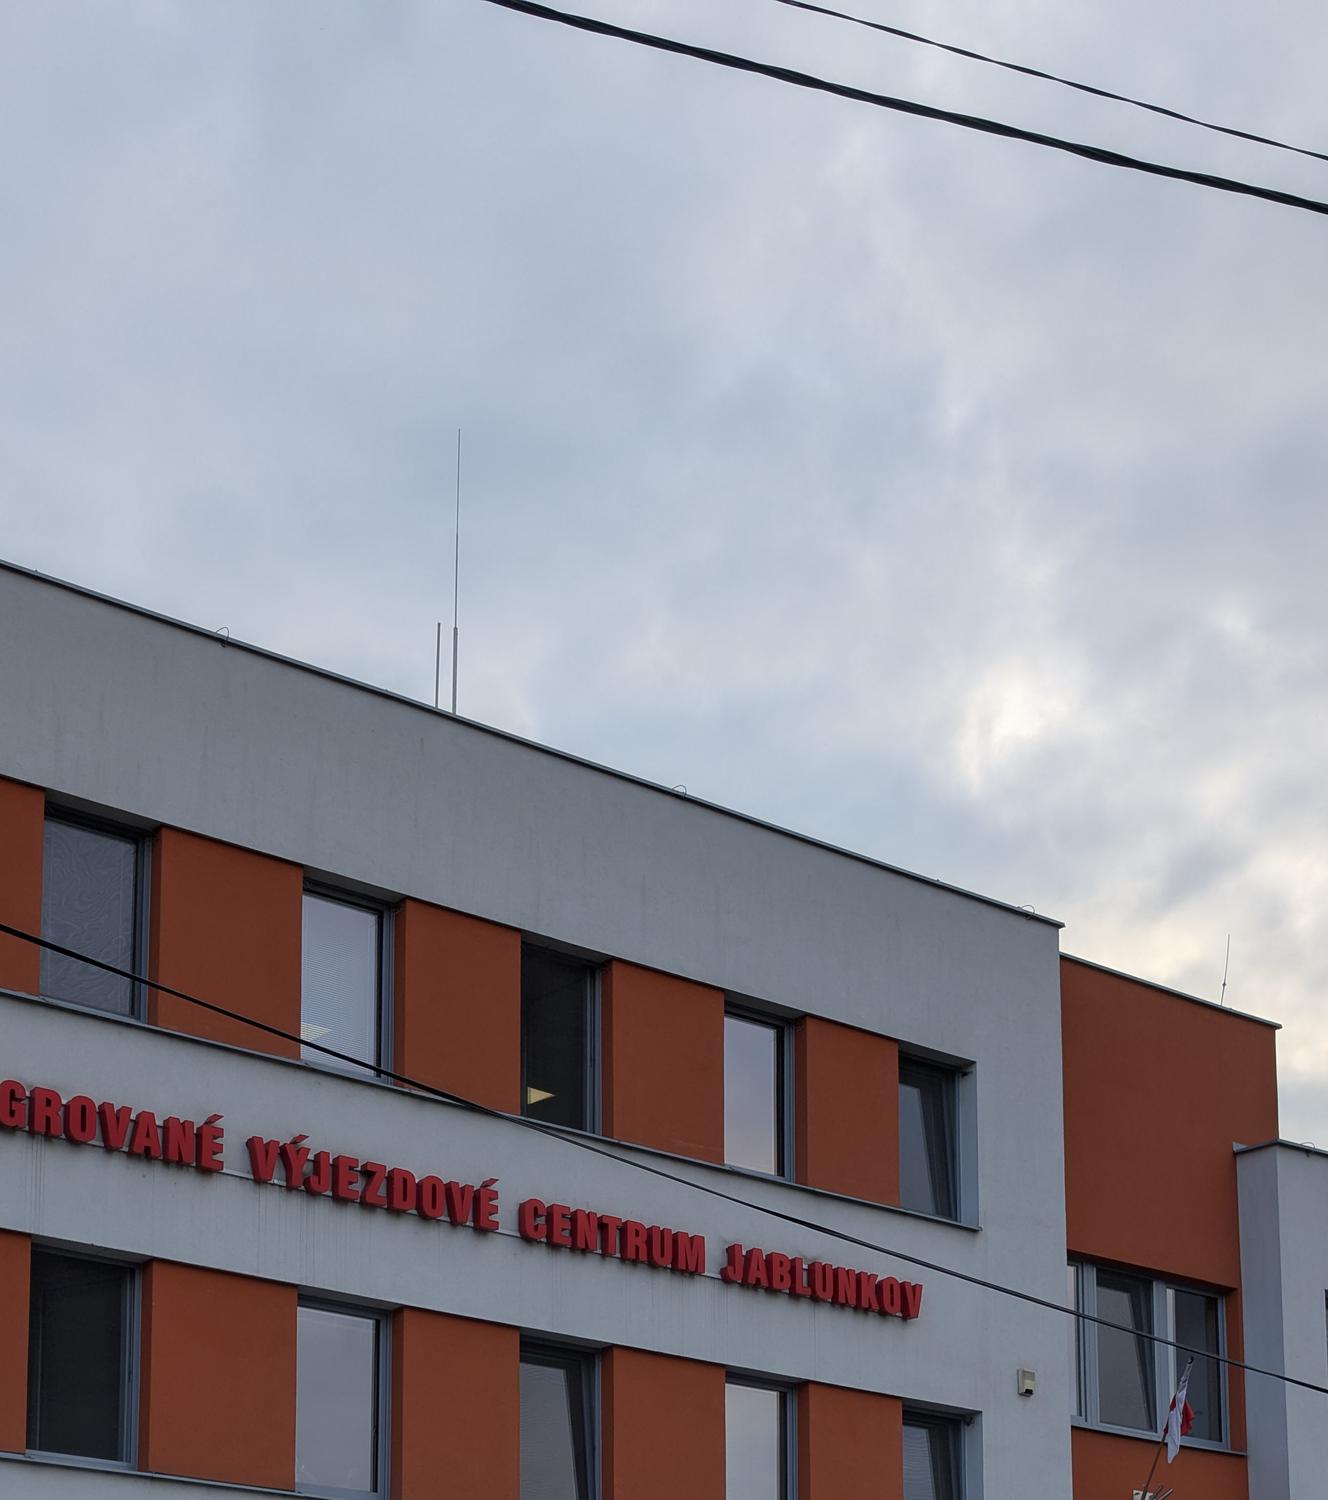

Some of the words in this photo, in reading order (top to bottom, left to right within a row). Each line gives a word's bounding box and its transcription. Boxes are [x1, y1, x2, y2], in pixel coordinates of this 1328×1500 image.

[246, 1134, 500, 1232] VÝJEZDOVÉ
[518, 1198, 706, 1275] CENTRUM
[720, 1243, 923, 1320] JABLUNKOV
